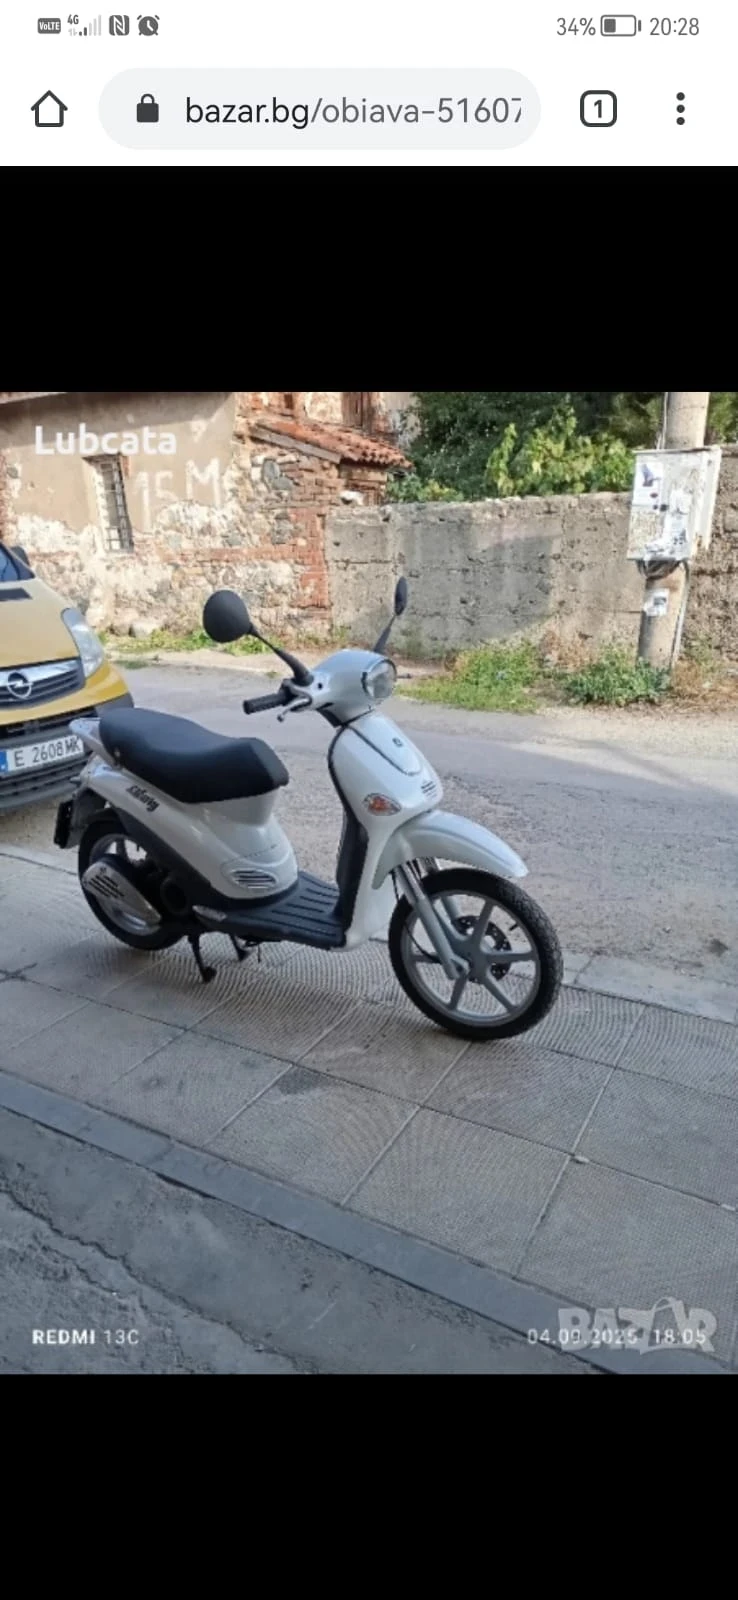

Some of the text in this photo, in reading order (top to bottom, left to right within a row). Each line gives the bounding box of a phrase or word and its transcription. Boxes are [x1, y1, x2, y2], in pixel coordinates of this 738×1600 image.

[39, 20, 60, 32] VoLTE
[67, 14, 79, 25] 4G
[556, 17, 596, 36] 34%
[650, 17, 700, 36] 20:28
[593, 98, 603, 119] 1
[14, 750, 25, 768] E
[32, 741, 64, 763] 2608
